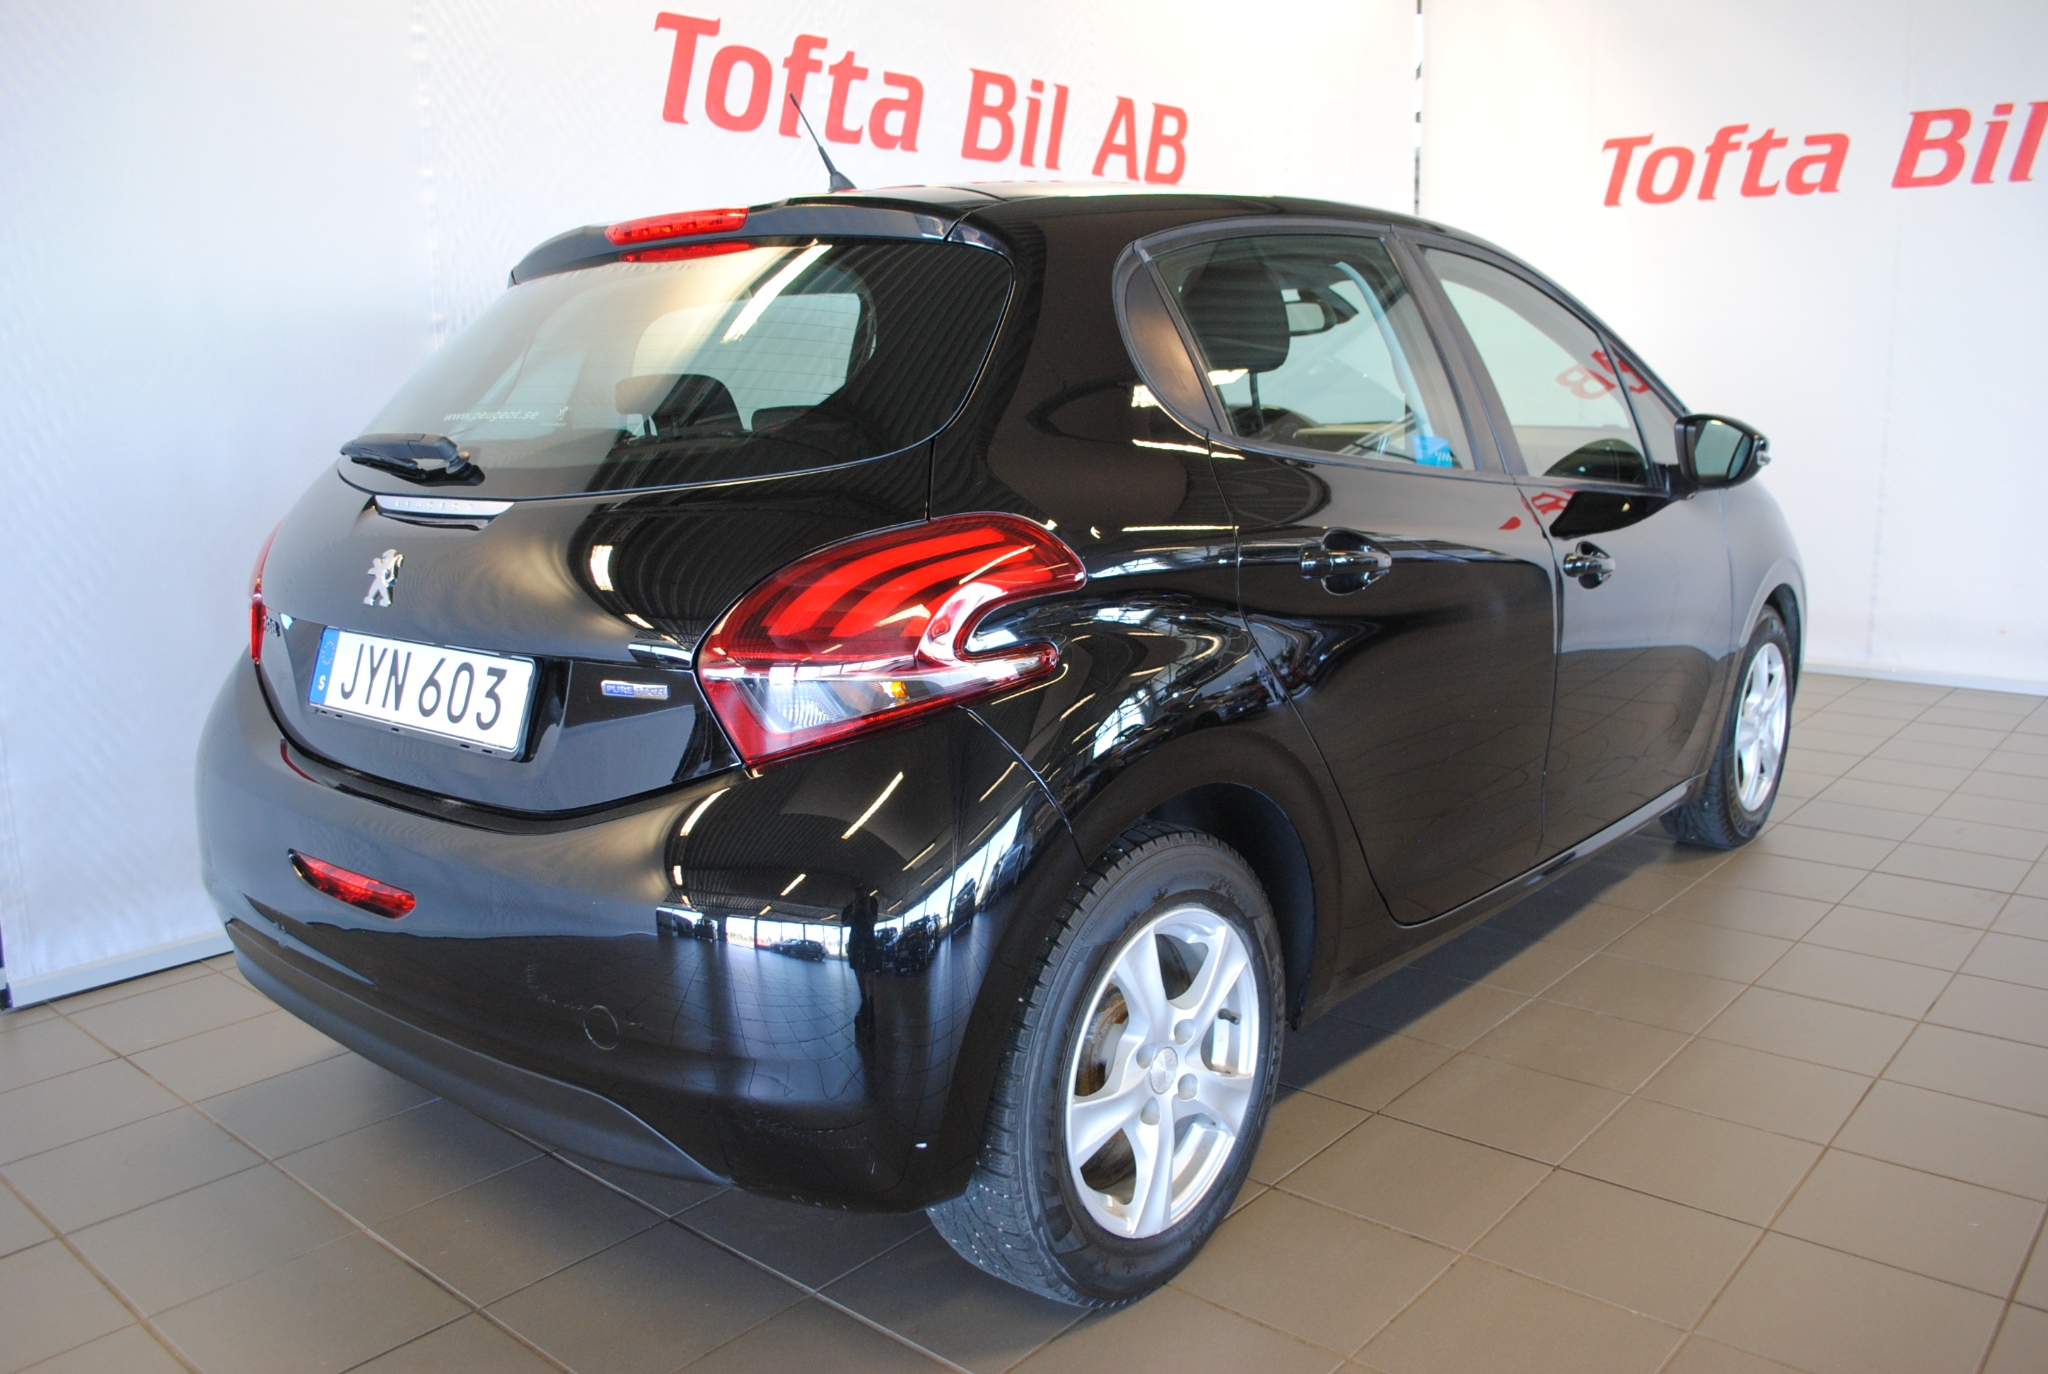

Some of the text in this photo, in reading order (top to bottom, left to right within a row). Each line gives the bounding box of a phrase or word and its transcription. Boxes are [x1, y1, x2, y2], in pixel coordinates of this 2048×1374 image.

[655, 12, 1189, 184] Tofta Bil AB
[1602, 101, 2048, 207] Tofta Bil
[443, 410, 539, 421] www.peugeot.se
[317, 675, 326, 691] S
[341, 643, 507, 731] JYN 603
